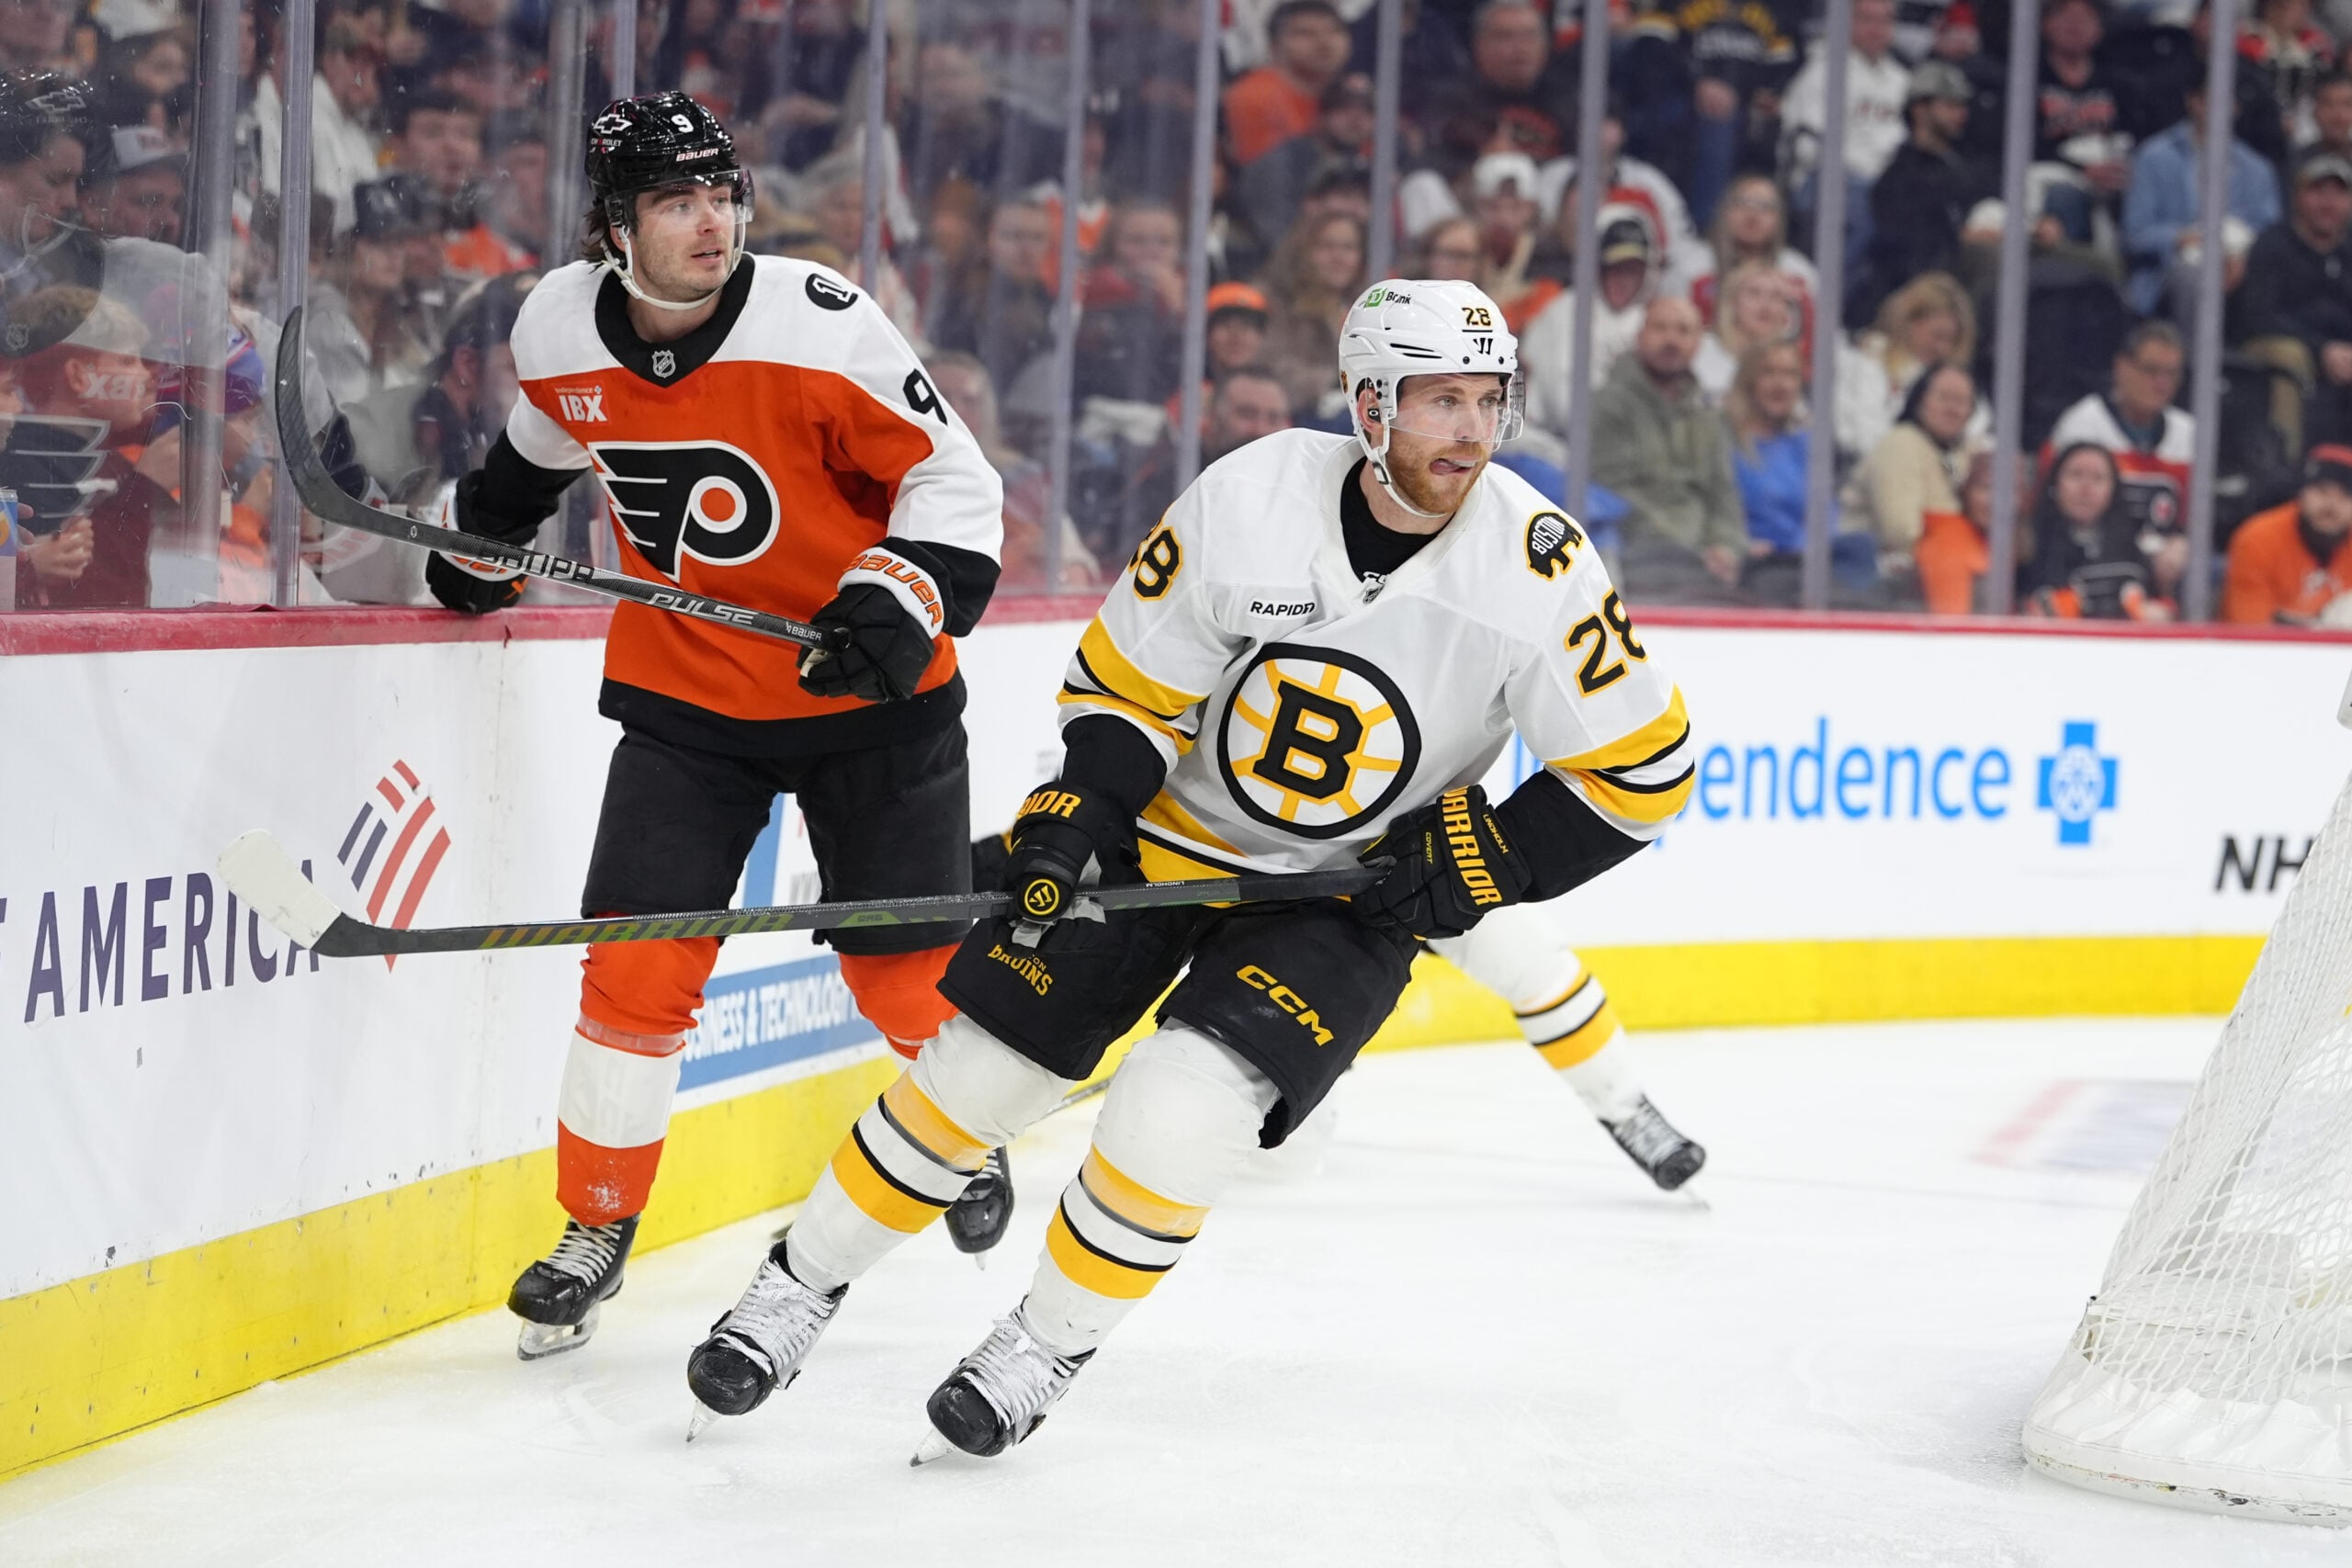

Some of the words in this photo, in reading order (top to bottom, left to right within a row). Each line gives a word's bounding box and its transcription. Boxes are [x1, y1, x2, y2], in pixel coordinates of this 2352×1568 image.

[671, 114, 695, 133] 9
[591, 139, 623, 148] CHROLET
[675, 147, 719, 163] BAUER
[1462, 307, 1492, 326] 28
[559, 395, 608, 423] IBX
[902, 367, 948, 427] 9
[1128, 516, 1183, 602] 8
[646, 592, 761, 626] PULSE
[790, 625, 823, 642] BAUER
[1564, 588, 1648, 698] 28
[1250, 677, 1367, 802] B
[1425, 831, 1433, 864] COVERT
[1482, 814, 1510, 854] LINDHOLM
[478, 914, 795, 950] WARRIOR
[1236, 964, 1335, 1047] CCM
